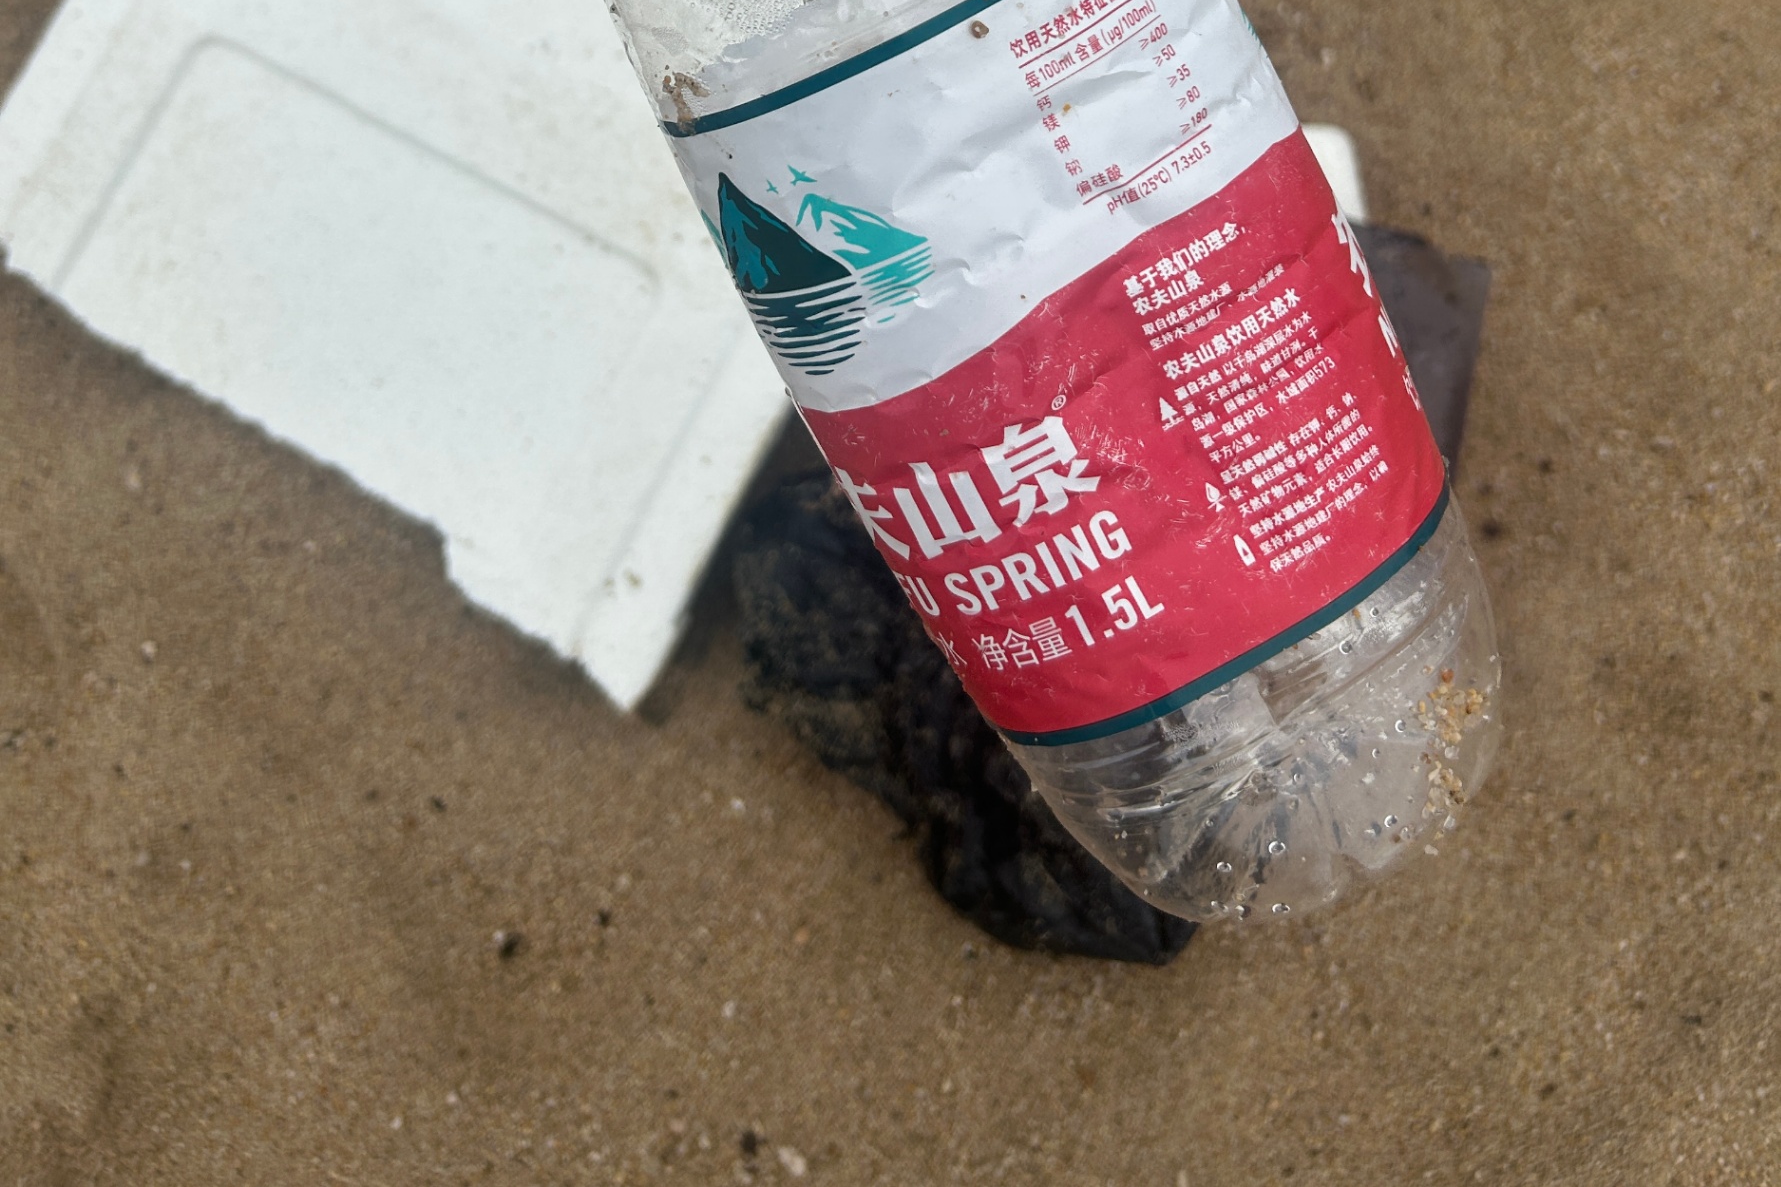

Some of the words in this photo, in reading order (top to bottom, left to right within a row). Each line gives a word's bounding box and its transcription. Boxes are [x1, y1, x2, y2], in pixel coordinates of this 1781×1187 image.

[1036, 95, 1052, 112] 钙
[1042, 113, 1060, 131] 镁
[1054, 135, 1071, 154] 钾
[1065, 159, 1083, 177] 钠
[1076, 164, 1124, 197] 偏硅酸
[1133, 270, 1204, 315] 农夫山泉
[1142, 281, 1232, 335] 取自优质天然水源
[1163, 288, 1300, 380] 农夫山泉饮用天然水
[945, 511, 1131, 616] SPRING
